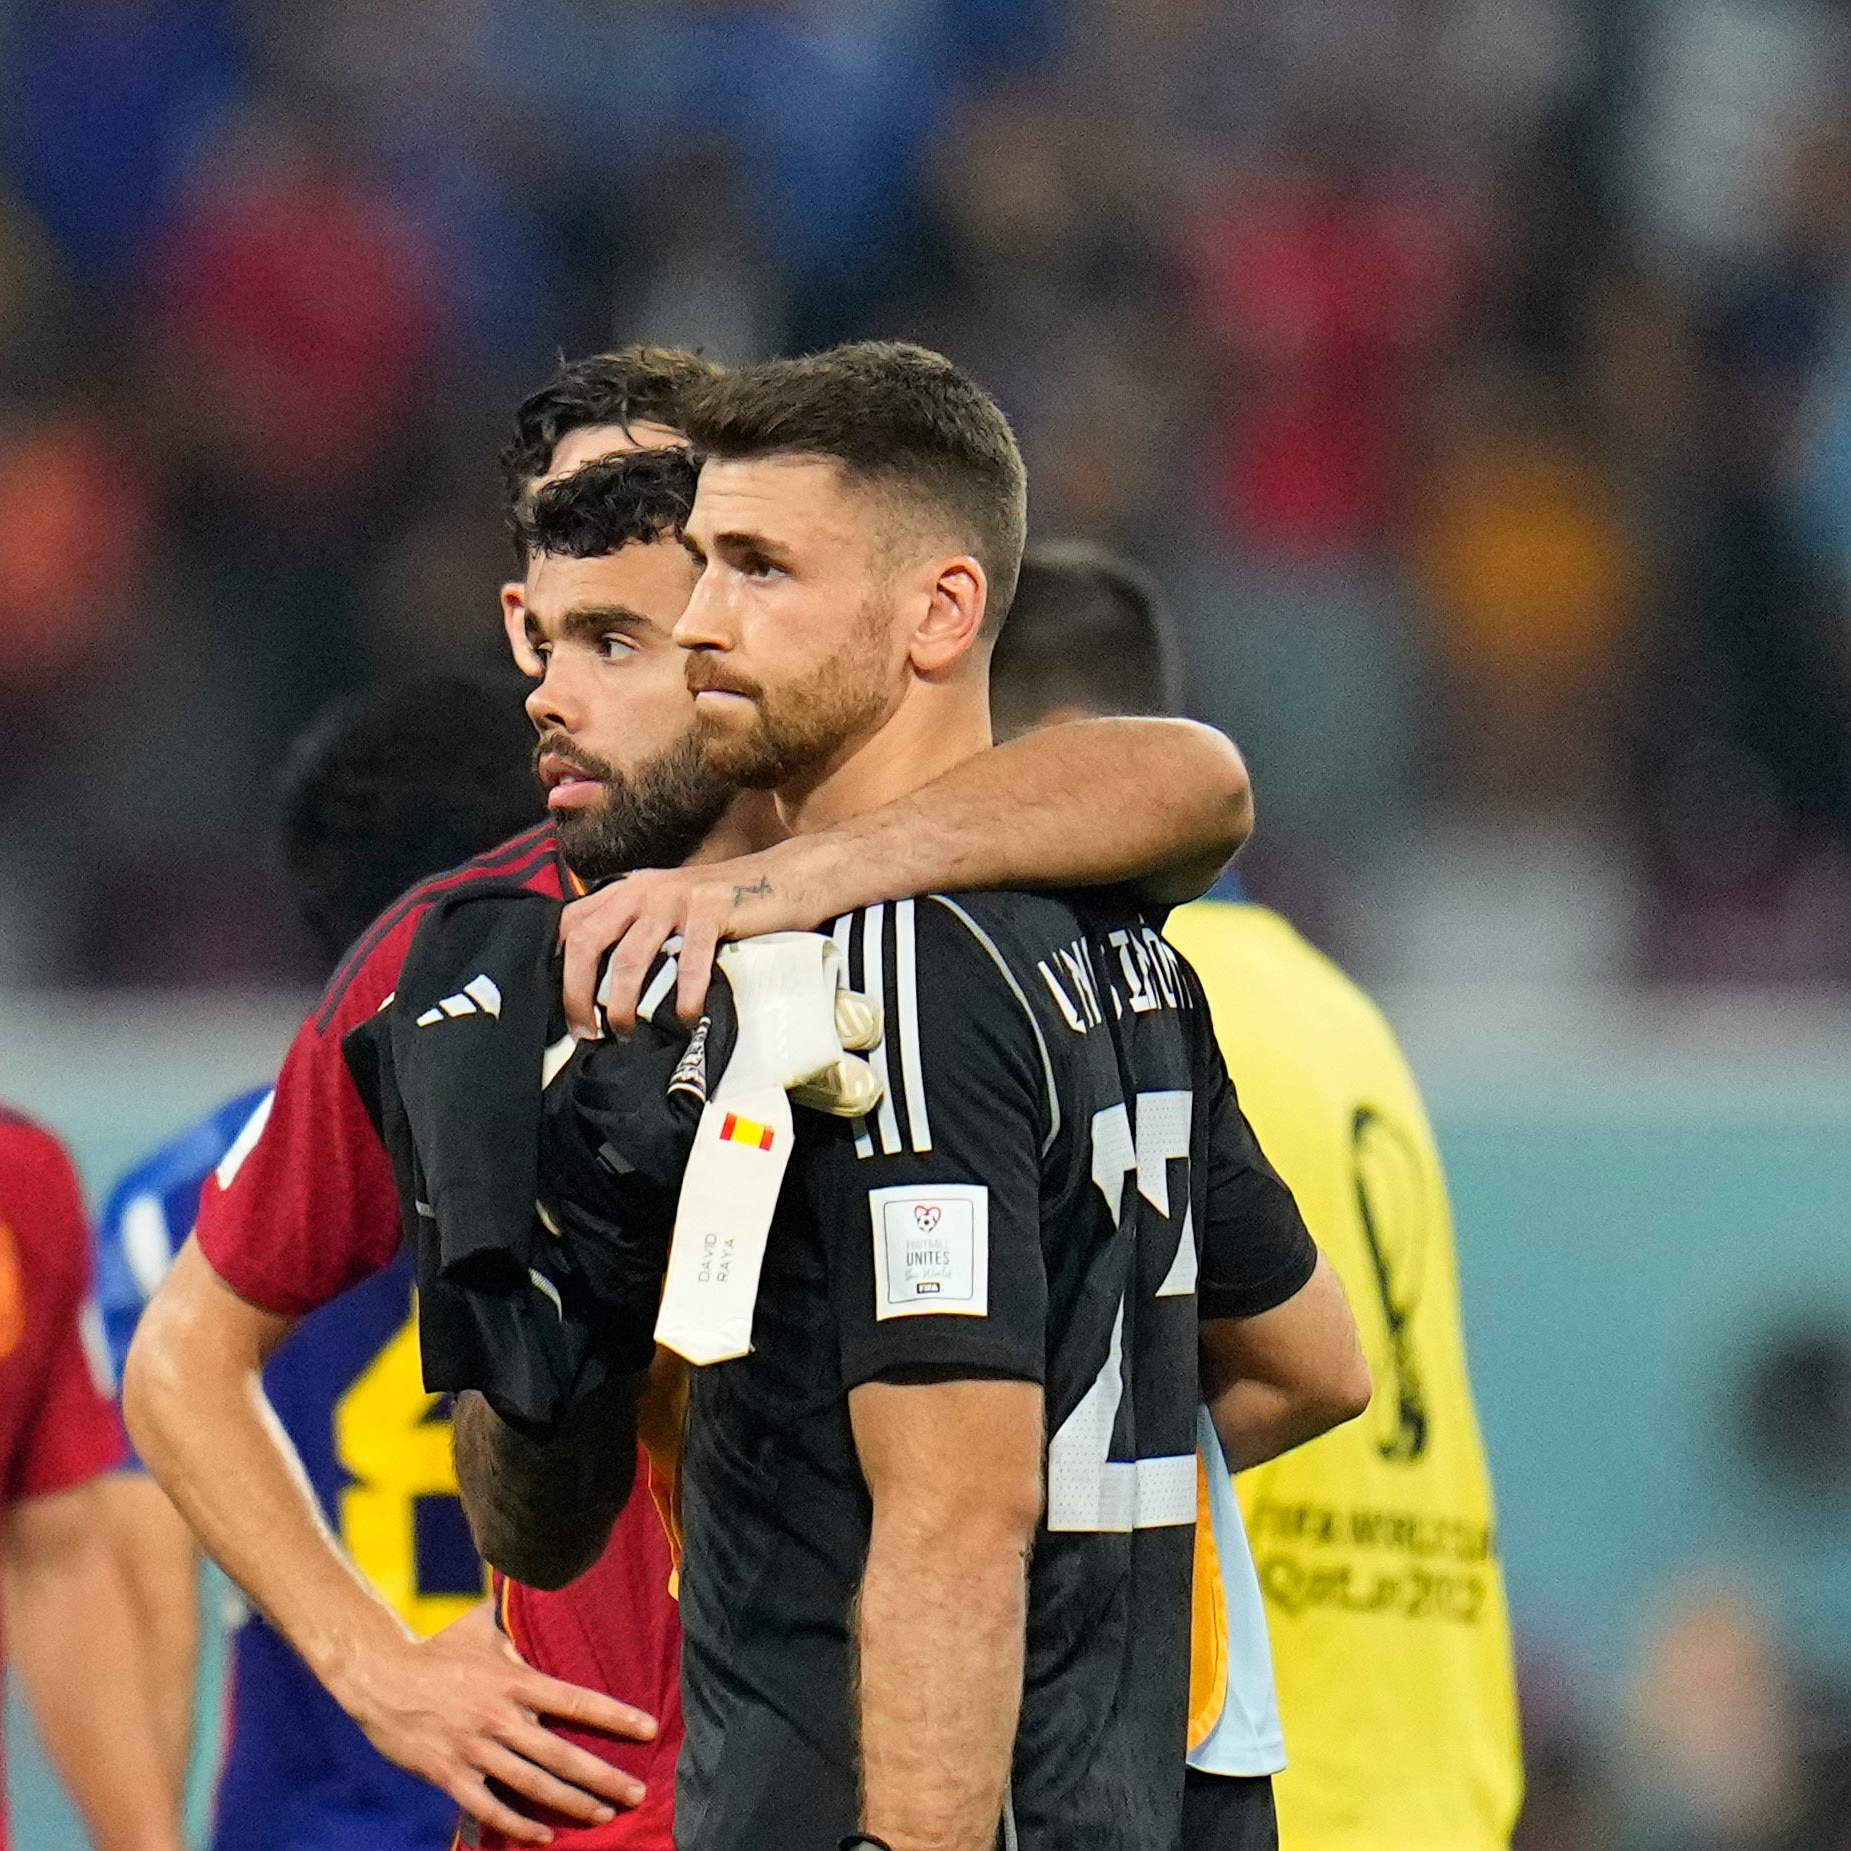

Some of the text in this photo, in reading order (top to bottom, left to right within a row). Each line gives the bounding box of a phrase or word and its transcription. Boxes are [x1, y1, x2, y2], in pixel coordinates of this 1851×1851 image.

[698, 1232, 718, 1283] DAVID
[716, 1237, 736, 1283] RAYA
[906, 1250, 951, 1267] UNITES
